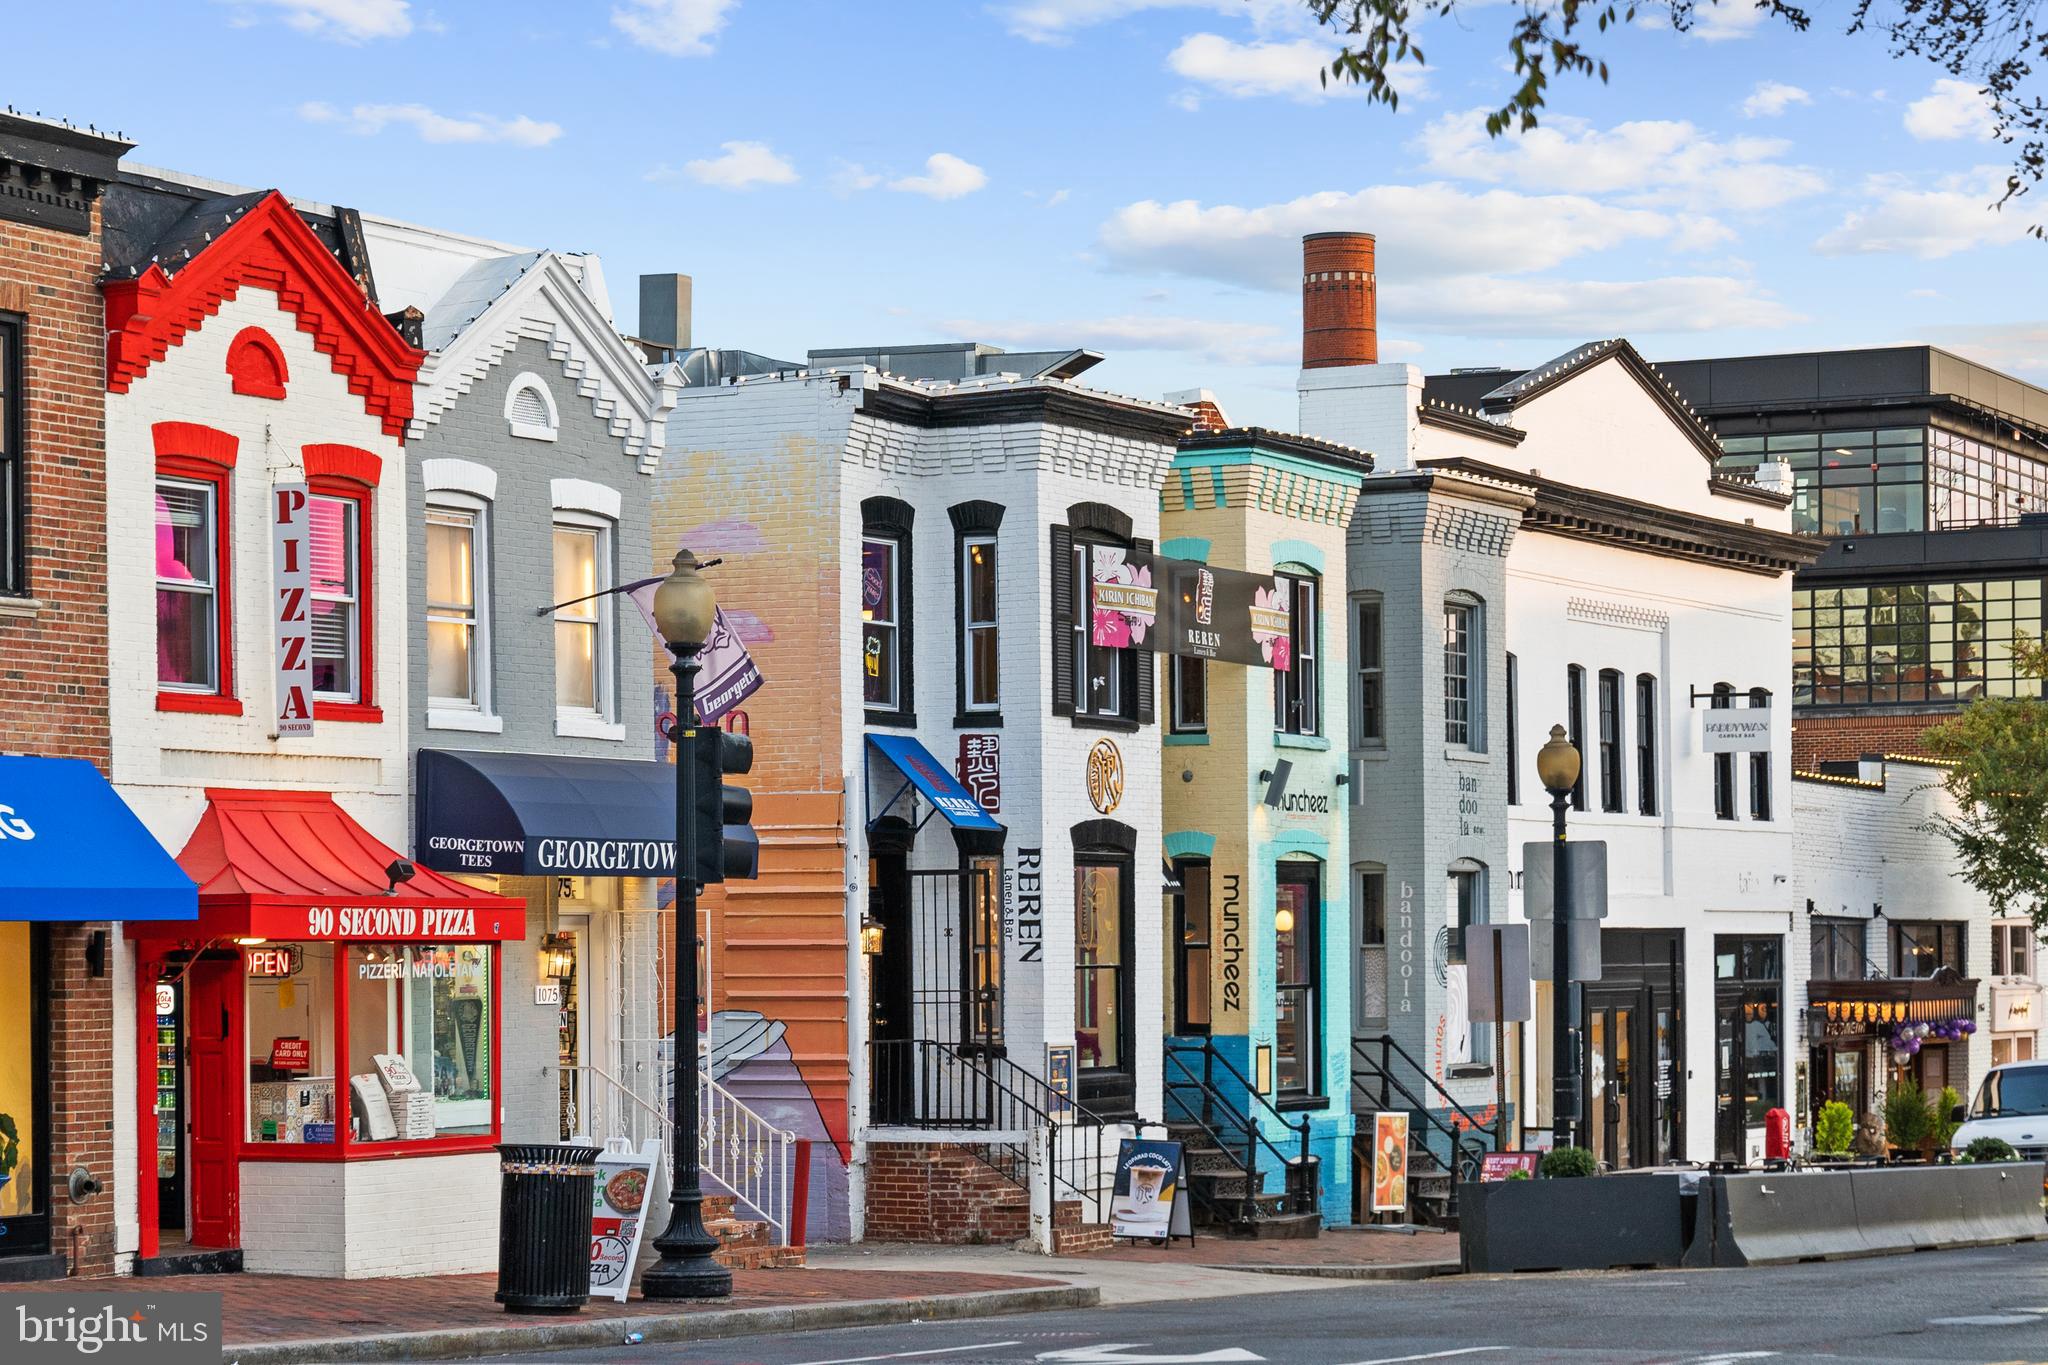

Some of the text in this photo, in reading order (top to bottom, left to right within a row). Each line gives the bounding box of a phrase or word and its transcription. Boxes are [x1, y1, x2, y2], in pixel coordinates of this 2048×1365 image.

[276, 490, 311, 720] PIZZA
[1098, 589, 1154, 608] KIRIN ICHIBAN
[1188, 629, 1220, 647] REREN
[287, 723, 311, 732] SECOND
[1458, 770, 1477, 793] ban
[1458, 794, 1478, 815] doo
[429, 836, 525, 853] GEORGETOWN
[459, 853, 492, 868] TEES
[1004, 868, 1014, 941] Lamen & Bar
[1017, 847, 1042, 962] REREN
[308, 907, 476, 937] 90 SECOND PIZZA
[1223, 874, 1244, 1012] muncheez
[1400, 881, 1413, 1013] bandoola
[538, 987, 559, 1002] 1075
[275, 1049, 308, 1058] CARD ONLY
[280, 1042, 302, 1050] CREDIT
[1148, 1152, 1163, 1161] COCO
[600, 1254, 624, 1262] Second
